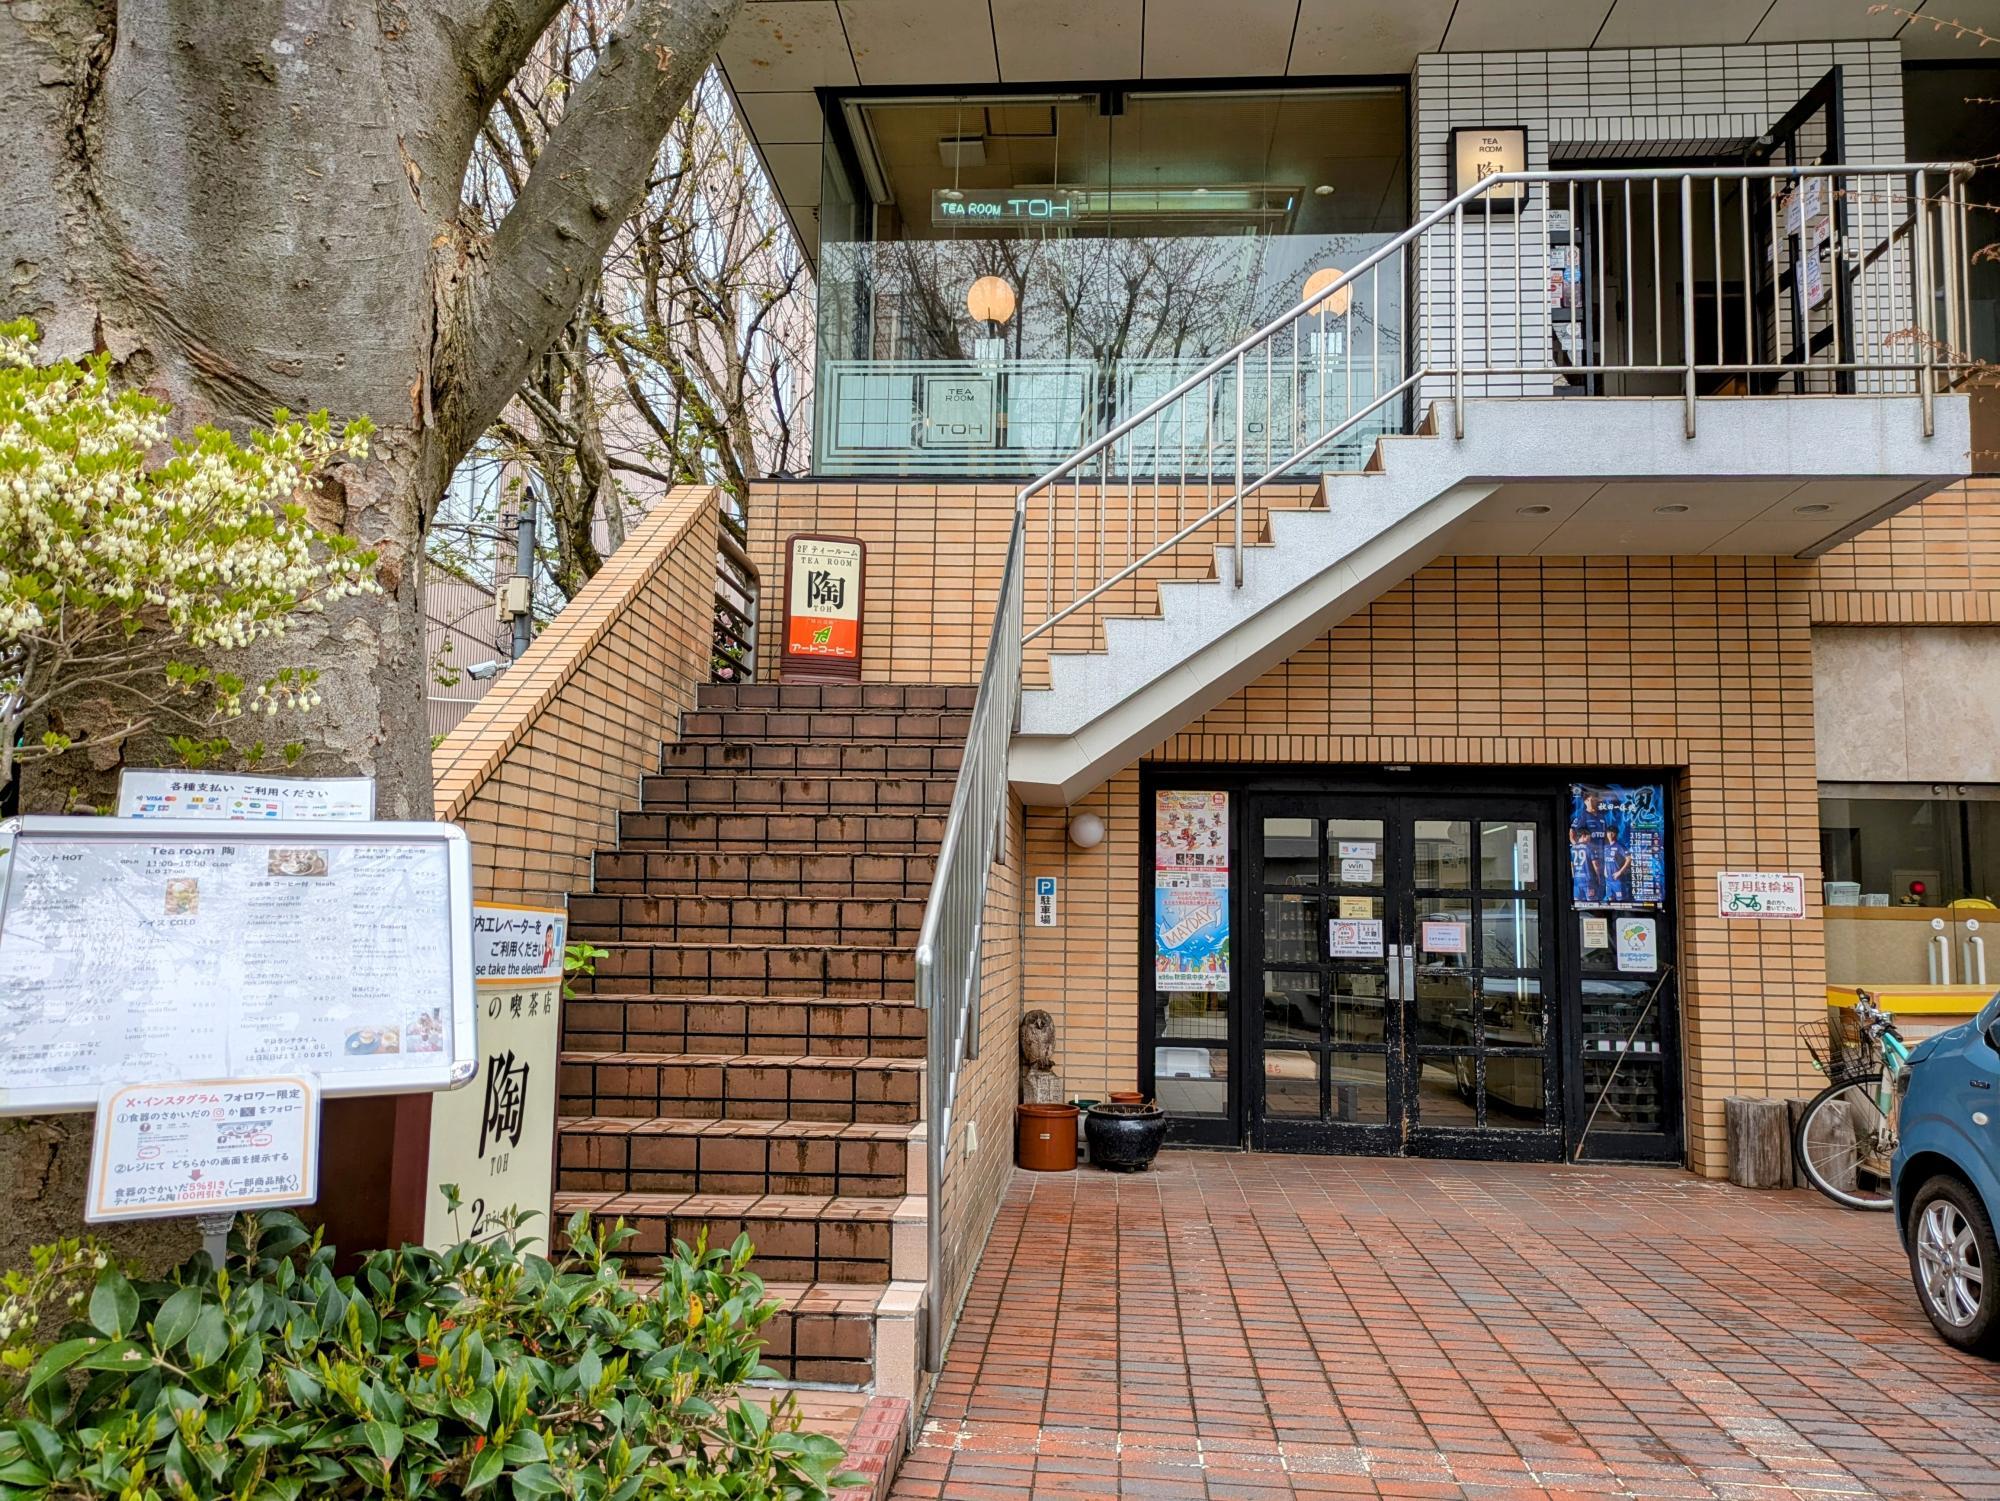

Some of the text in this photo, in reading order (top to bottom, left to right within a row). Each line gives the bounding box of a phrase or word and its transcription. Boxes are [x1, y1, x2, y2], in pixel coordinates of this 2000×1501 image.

[941, 199, 1070, 217] TEA ROOM TOH
[936, 423, 983, 435] TOH
[797, 544, 858, 557] 2F ティールーム
[801, 556, 852, 567] TEA ROOM
[807, 570, 846, 610] 陶
[813, 604, 833, 613] TOH
[791, 643, 853, 655] アートコーヒー
[170, 781, 329, 798] 各種支払い ご利用ください
[151, 847, 176, 855] Tea
[1041, 881, 1051, 894] P
[1728, 881, 1795, 894] 専用駐輪場
[169, 918, 196, 927] COLD
[473, 914, 542, 935] 内エレベーターを
[1166, 907, 1212, 946] MAYDAY
[490, 941, 544, 957] ご利用ください
[488, 962, 507, 976] take
[508, 961, 520, 976] the
[223, 1089, 301, 1103] フォロワー限定
[229, 1108, 239, 1117] か
[259, 1104, 303, 1114] をフォロー
[478, 1048, 530, 1160] 陶
[171, 1153, 290, 1169] どちらかの画面を提示する
[490, 1152, 509, 1177] TOH
